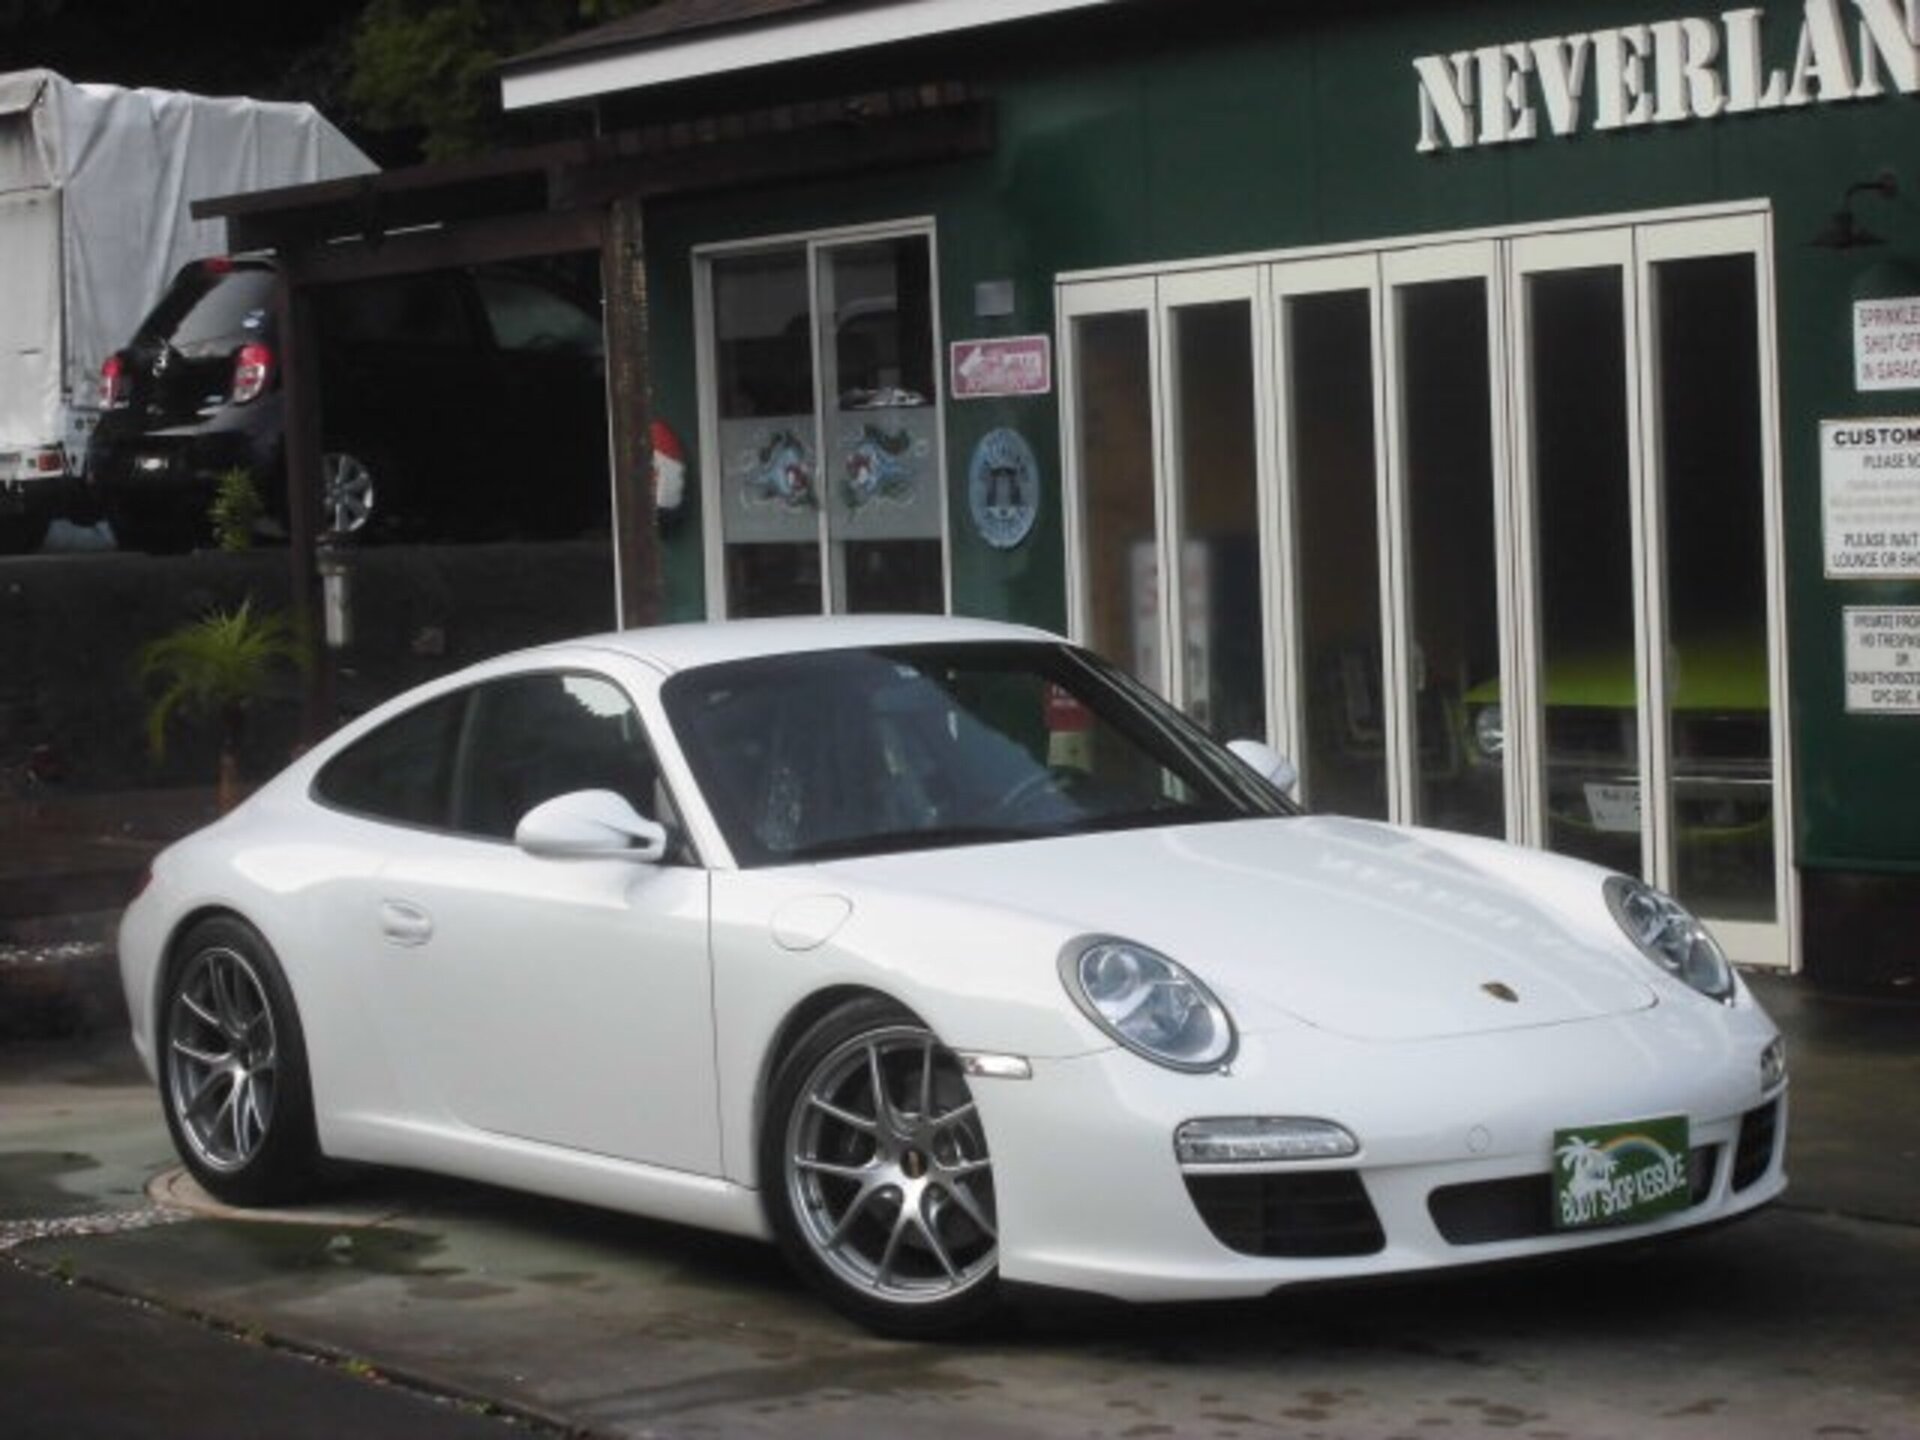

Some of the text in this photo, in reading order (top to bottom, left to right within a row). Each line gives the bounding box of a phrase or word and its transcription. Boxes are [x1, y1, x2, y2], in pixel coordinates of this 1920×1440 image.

[1413, 0, 1920, 152] NEVERLAN
[1863, 453, 1904, 470] PLEASE
[1843, 531, 1918, 548] PLEASE WAIT
[1833, 552, 1878, 568] LOUNGE
[1881, 552, 1896, 568] OR
